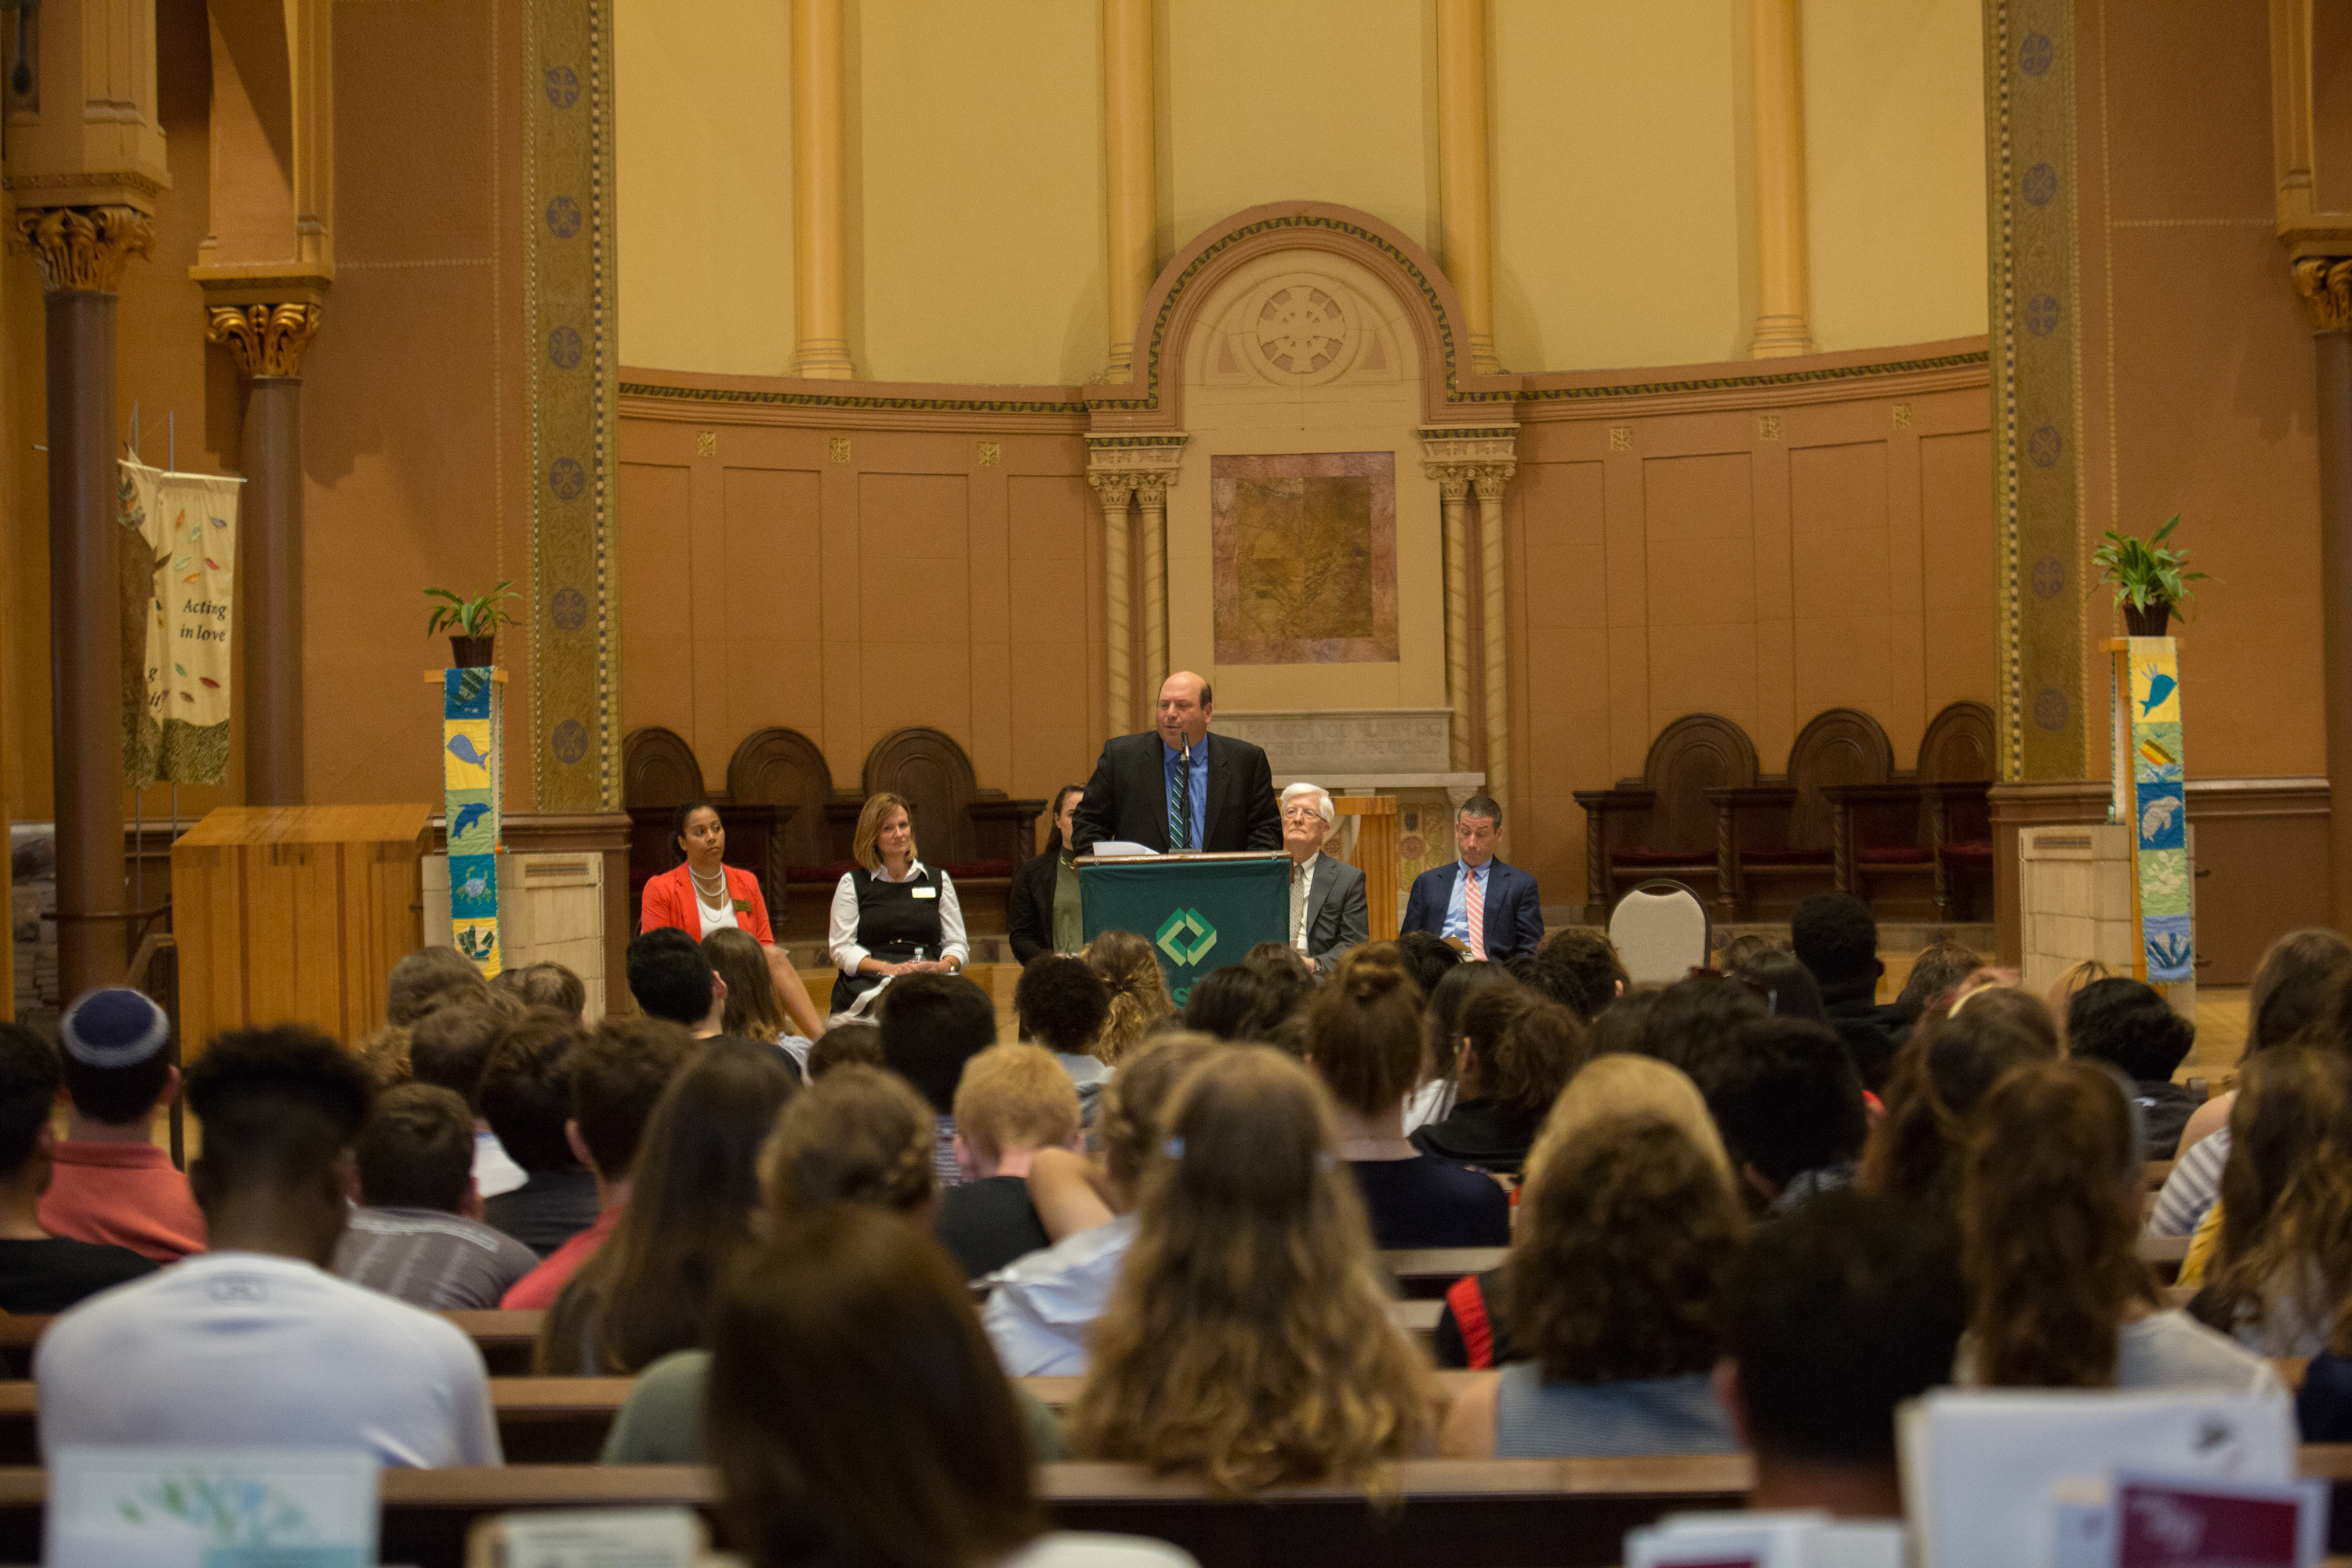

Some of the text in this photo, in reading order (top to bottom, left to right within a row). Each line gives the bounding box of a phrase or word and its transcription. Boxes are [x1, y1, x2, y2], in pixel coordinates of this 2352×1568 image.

[183, 598, 227, 621] Acting
[180, 624, 226, 641] in love
